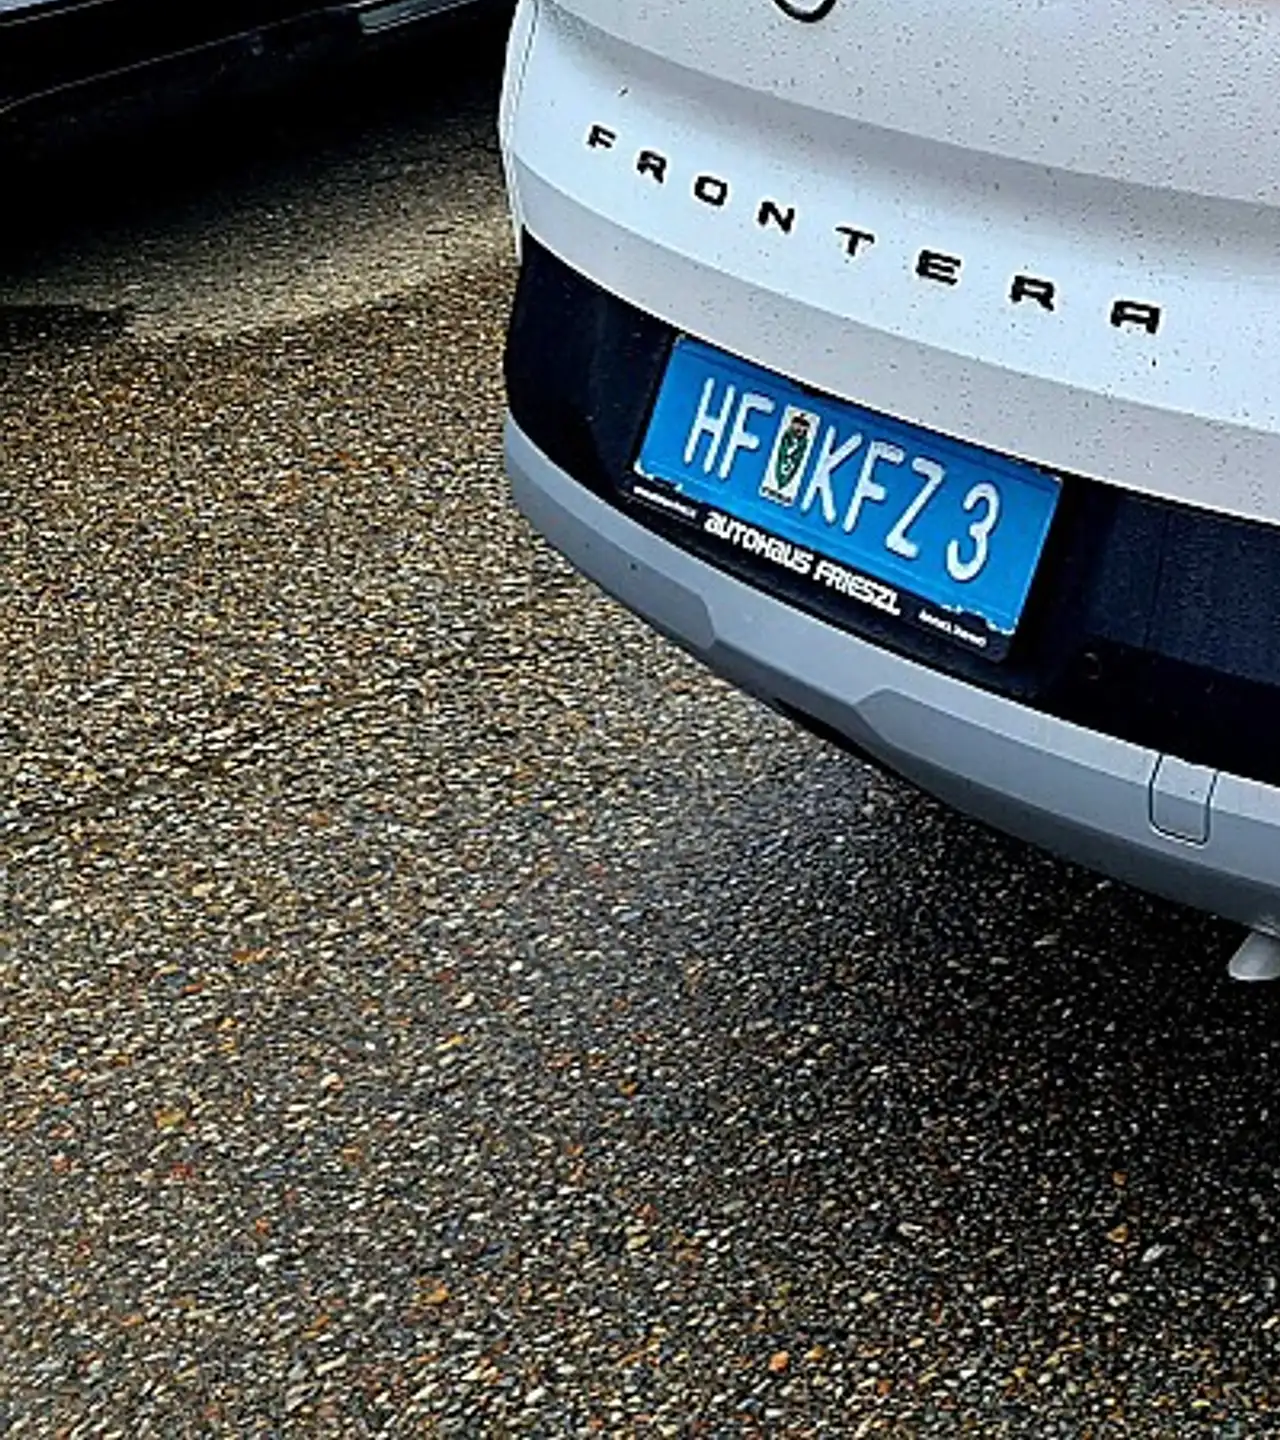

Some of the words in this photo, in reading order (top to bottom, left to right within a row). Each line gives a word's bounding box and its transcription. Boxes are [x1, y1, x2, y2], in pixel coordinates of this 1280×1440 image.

[585, 124, 1163, 335] FRONTERA
[683, 376, 776, 481] HF
[801, 424, 947, 559] KFZ
[946, 481, 1001, 582] 3
[812, 559, 902, 616] FRIESZL
